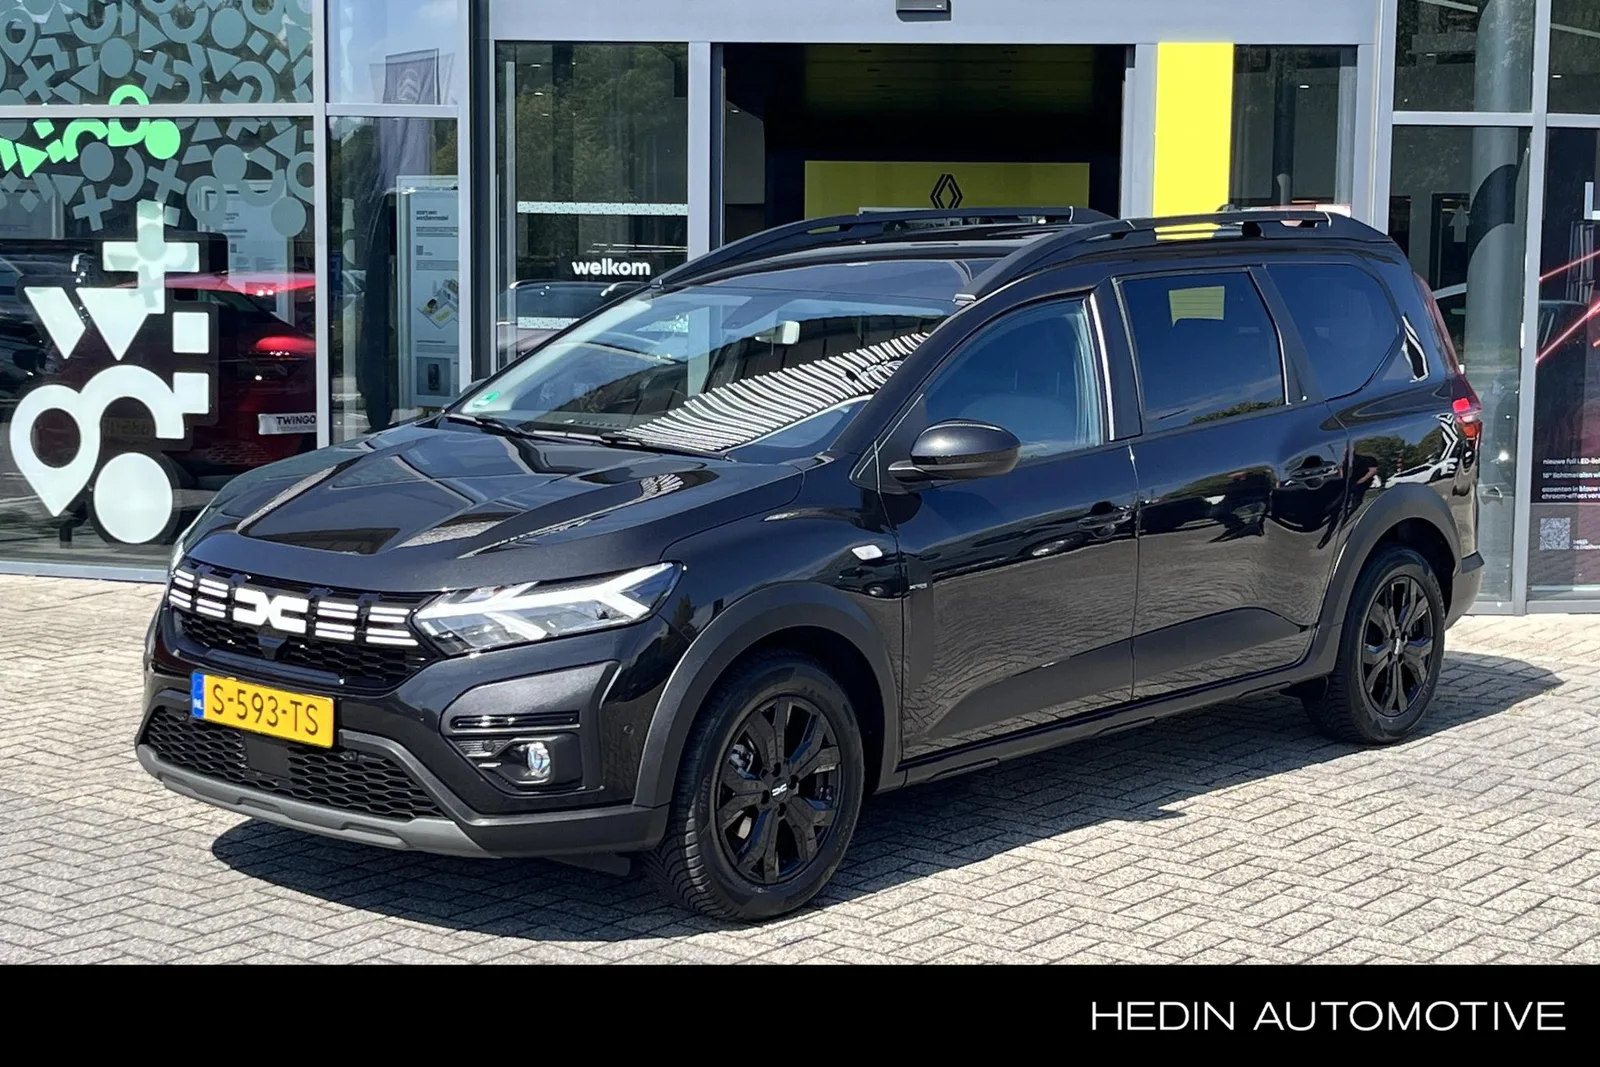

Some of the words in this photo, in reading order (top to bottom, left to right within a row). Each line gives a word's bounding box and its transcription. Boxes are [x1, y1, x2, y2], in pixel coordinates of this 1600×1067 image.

[571, 258, 651, 276] welkom
[276, 415, 316, 426] TWINGO
[212, 683, 319, 736] S-593-TS
